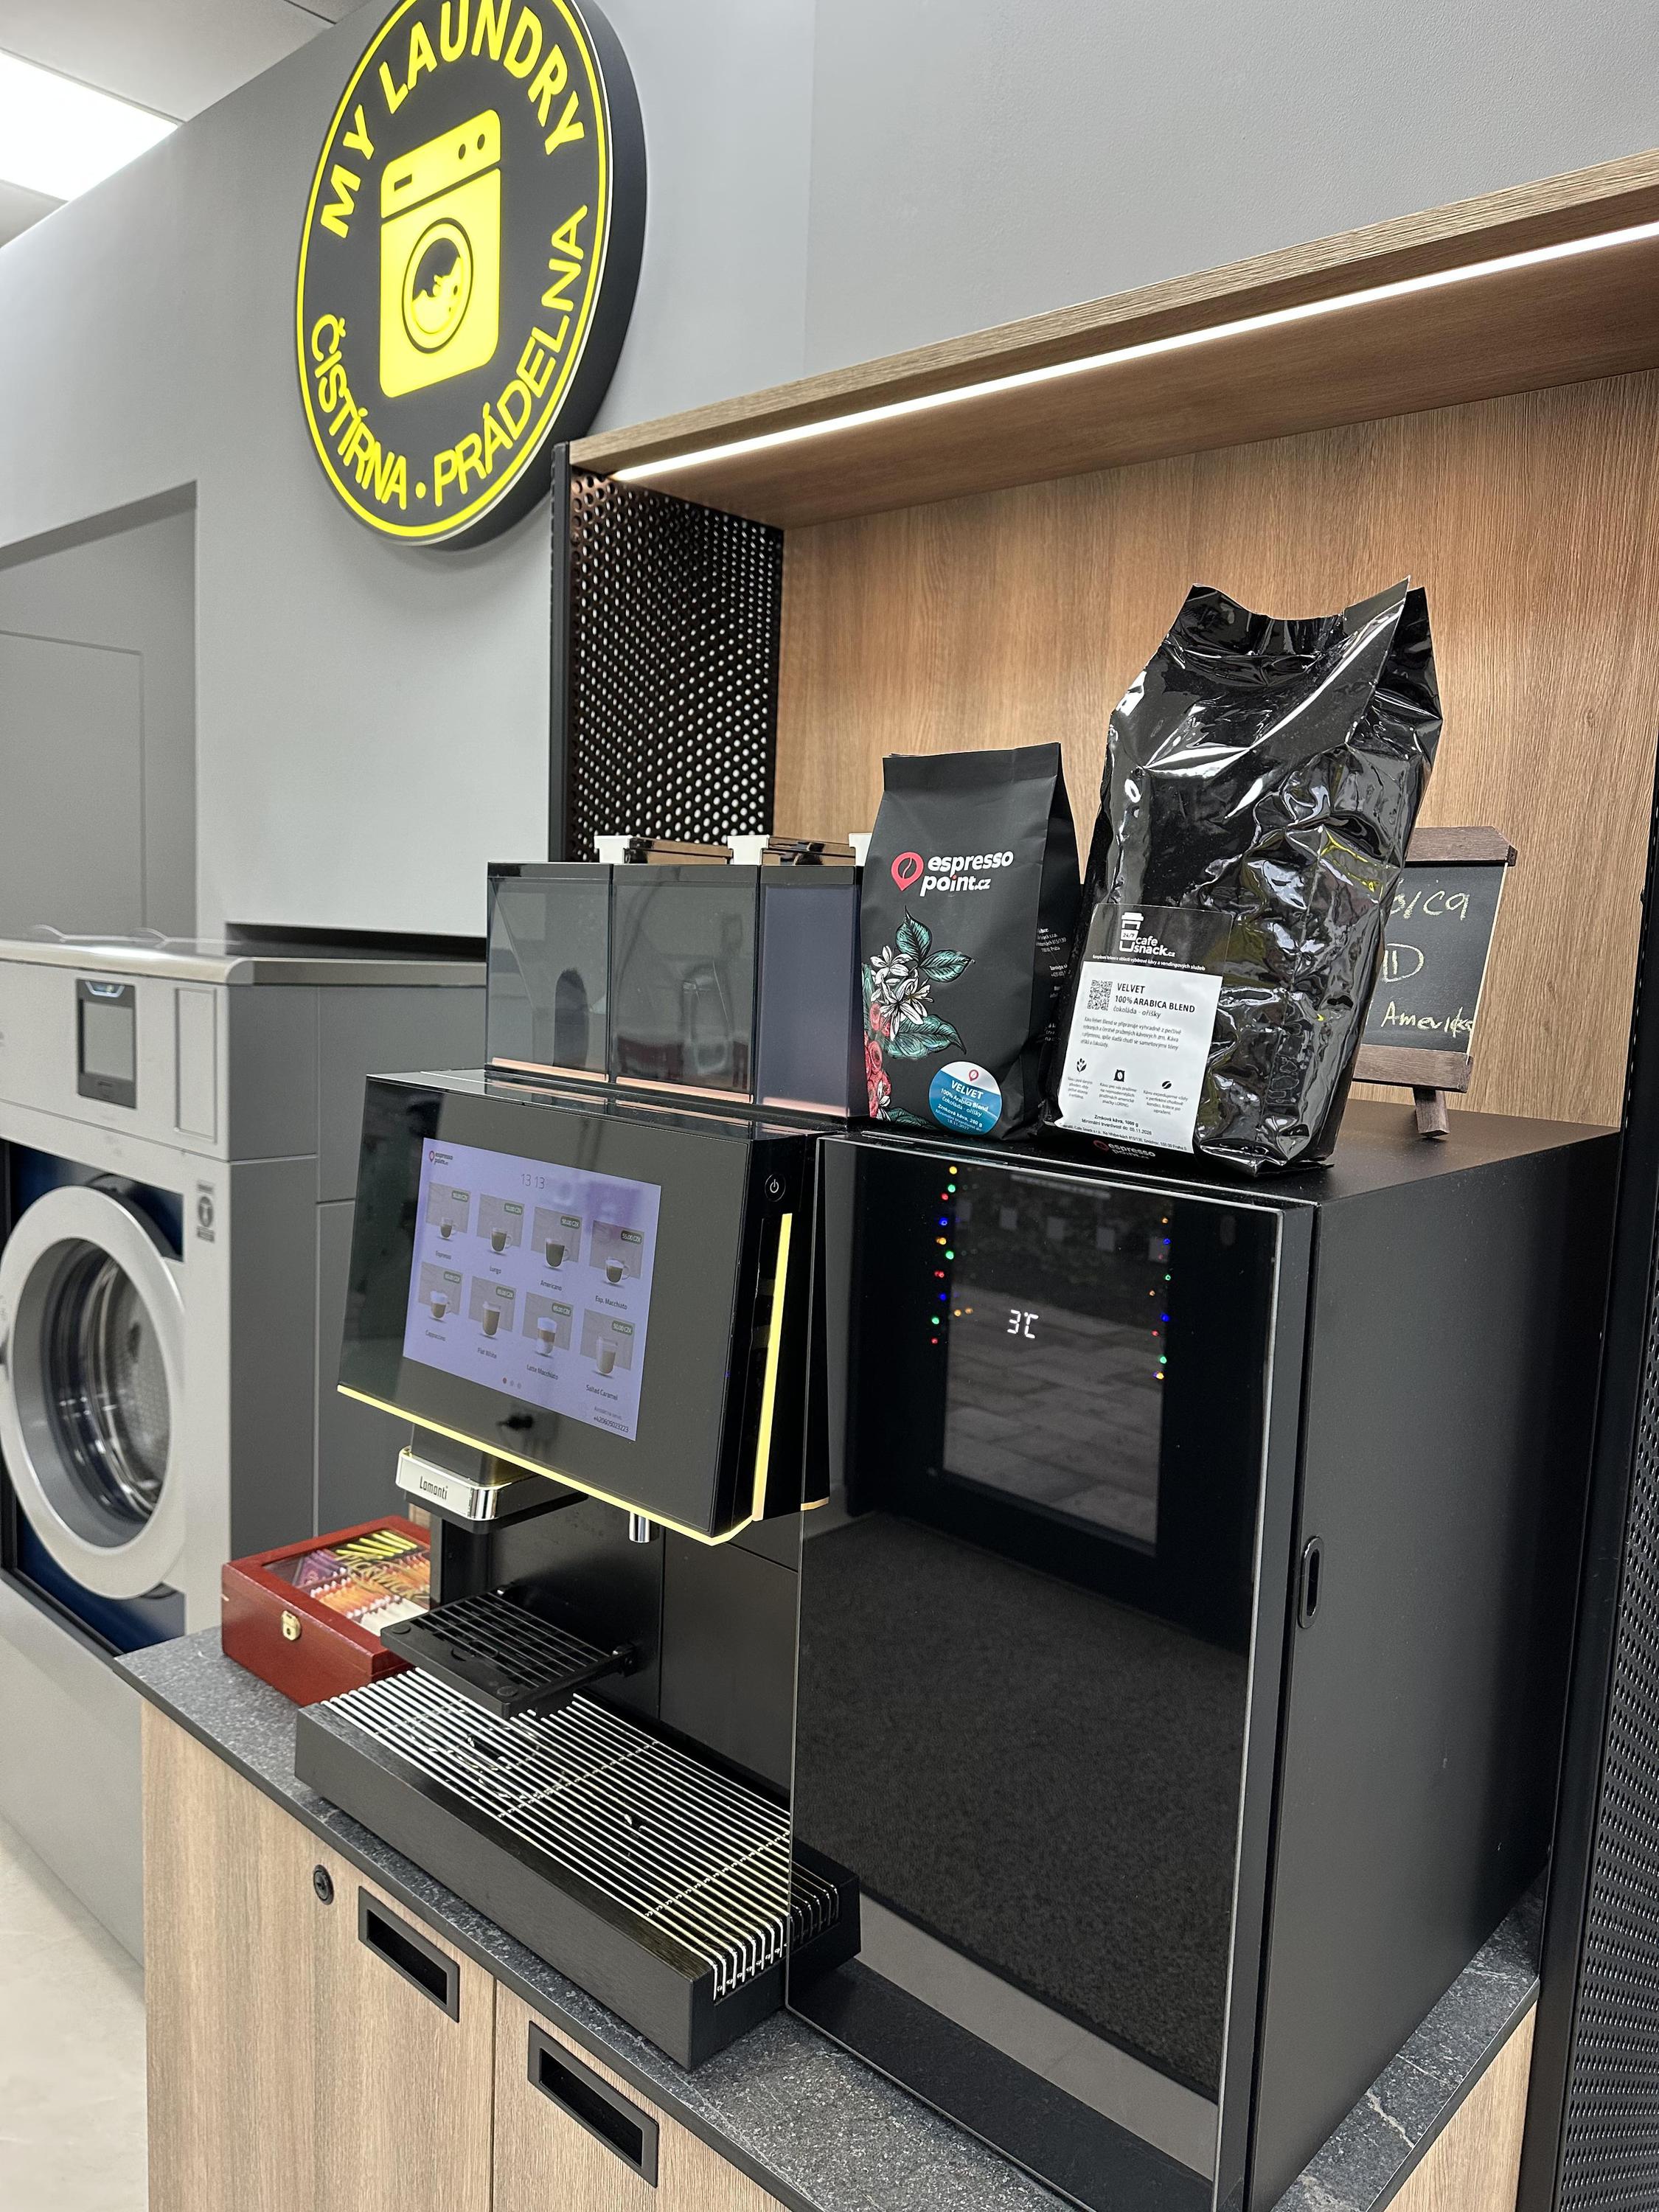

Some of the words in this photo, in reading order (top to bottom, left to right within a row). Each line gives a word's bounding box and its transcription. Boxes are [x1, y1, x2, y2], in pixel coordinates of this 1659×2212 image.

[319, 104, 375, 239] MY
[378, 0, 585, 157] LAUNDRY
[311, 313, 408, 510] ČISTÍRNA
[434, 204, 589, 508] PRÁDELNA
[928, 849, 1014, 874] espresso
[920, 874, 992, 897] point.cz
[1135, 936, 1158, 946] cafe
[1134, 945, 1175, 957] snack.cz
[1117, 983, 1145, 994] VELVET
[1113, 1006, 1137, 1015] čokoláda
[1142, 1010, 1161, 1019] oříšky
[1115, 995, 1133, 1004] 100%
[1133, 998, 1166, 1009] ARABICA
[1169, 1003, 1195, 1013] BLEND
[951, 1080, 984, 1099] VELVET
[941, 1088, 953, 1098] 100%
[953, 1095, 972, 1106] Arabica
[973, 1102, 989, 1111] Blend
[1108, 1144, 1155, 1157] espresso
[420, 1475, 448, 1500] Lamonti
